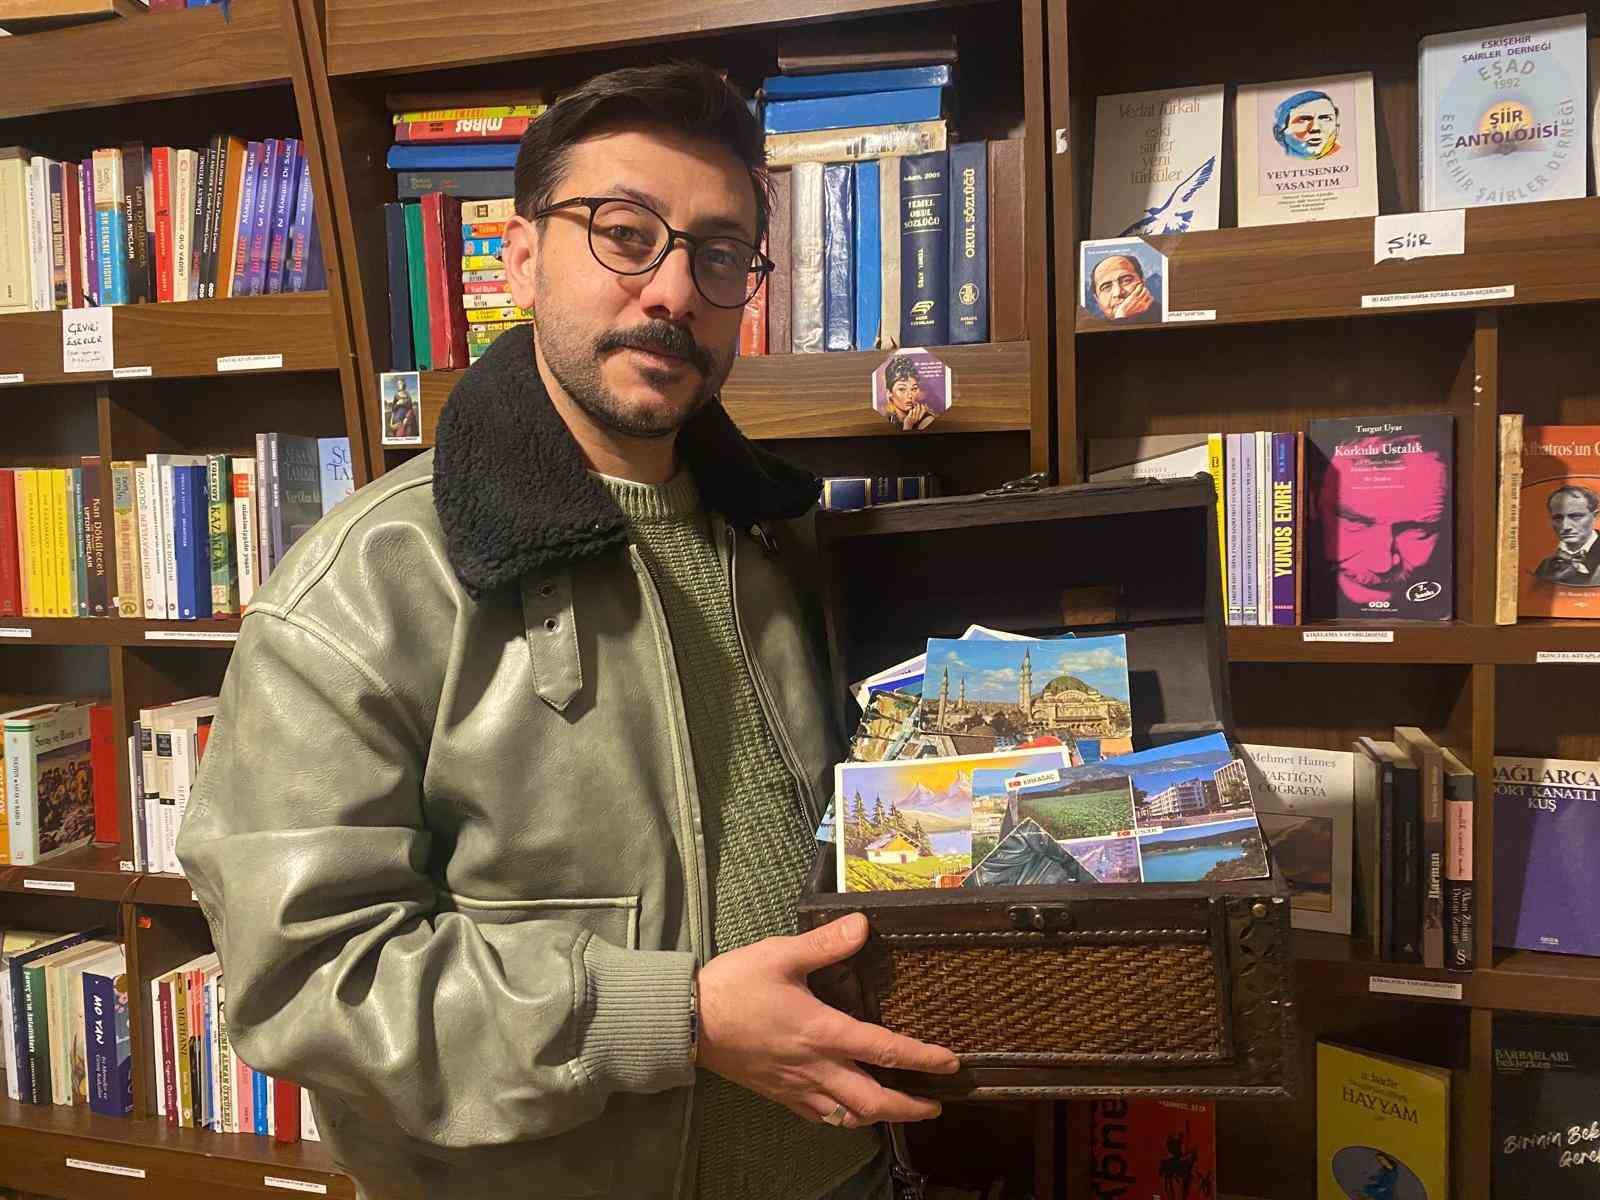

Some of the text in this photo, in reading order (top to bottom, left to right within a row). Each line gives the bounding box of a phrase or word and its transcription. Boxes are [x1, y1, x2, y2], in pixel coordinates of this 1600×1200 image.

[1490, 108, 1523, 130] ŞİİR
[1455, 121, 1559, 148] ANTOLOJİSİ
[962, 168, 976, 258] OKUL SÖZLÜĞÜ
[1335, 445, 1379, 457] Korkulu
[1274, 480, 1293, 578] YUNUS EMRE
[1527, 798, 1557, 812] KUŞ
[1532, 786, 1598, 801] KANATLI
[93, 995, 104, 1045] MO YAN
[1343, 1086, 1418, 1125] HAYYAM
